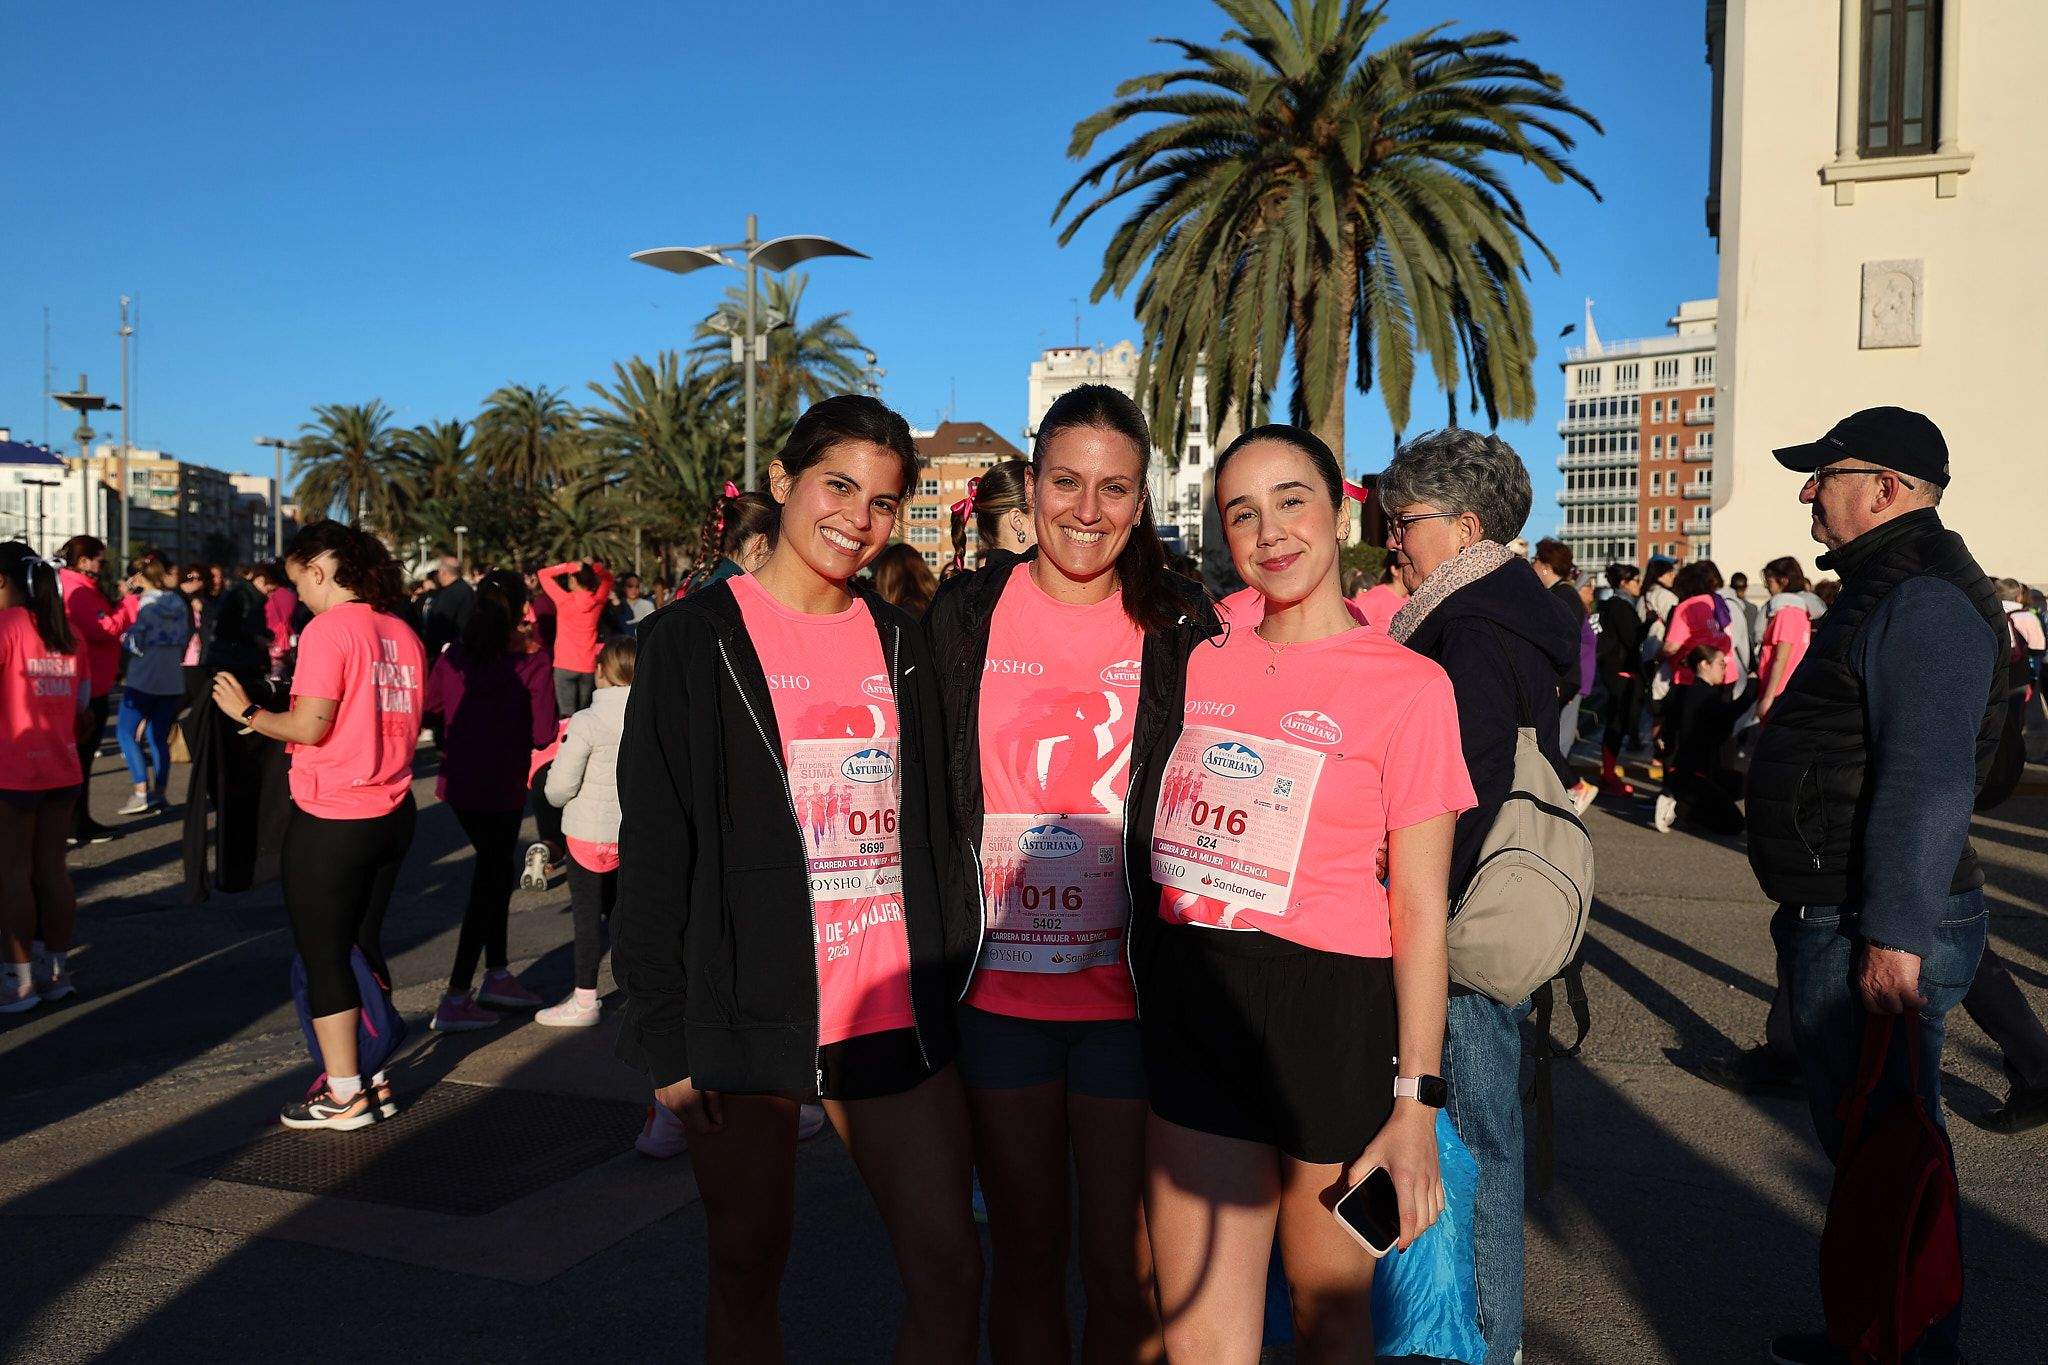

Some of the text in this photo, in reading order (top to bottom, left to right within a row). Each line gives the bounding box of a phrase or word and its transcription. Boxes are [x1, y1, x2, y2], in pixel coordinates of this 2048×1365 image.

[1184, 700, 1236, 718] OYSHO
[1284, 716, 1338, 743] ASTURIANA
[846, 761, 893, 775] ASTURIANA
[1205, 751, 1258, 775] ASTURIANA
[800, 769, 835, 779] SUMA
[849, 808, 896, 836] 016
[1191, 800, 1248, 836] 016
[860, 841, 884, 853] 8699
[988, 842, 1013, 852] SUMA
[1022, 837, 1079, 851] ASTURIANA
[1196, 835, 1217, 850] 624
[813, 860, 848, 870] CARRERA
[848, 860, 858, 868] DE
[859, 858, 869, 867] LA
[1158, 841, 1180, 855] CARRERA
[1180, 848, 1190, 857] DE
[1189, 850, 1198, 860] LA
[1199, 852, 1224, 867] MUJER
[1230, 860, 1269, 879] VALENCIA
[811, 876, 862, 891] OYSHO
[1212, 877, 1267, 901] Santander
[1021, 885, 1083, 911] 016
[1032, 918, 1062, 930] 5402
[825, 921, 845, 943] DE
[991, 932, 1020, 941] CARRERA
[1021, 933, 1031, 941] DE
[1031, 933, 1041, 942] LA
[1043, 933, 1070, 943] MUJER
[989, 948, 1033, 963] OYSHO
